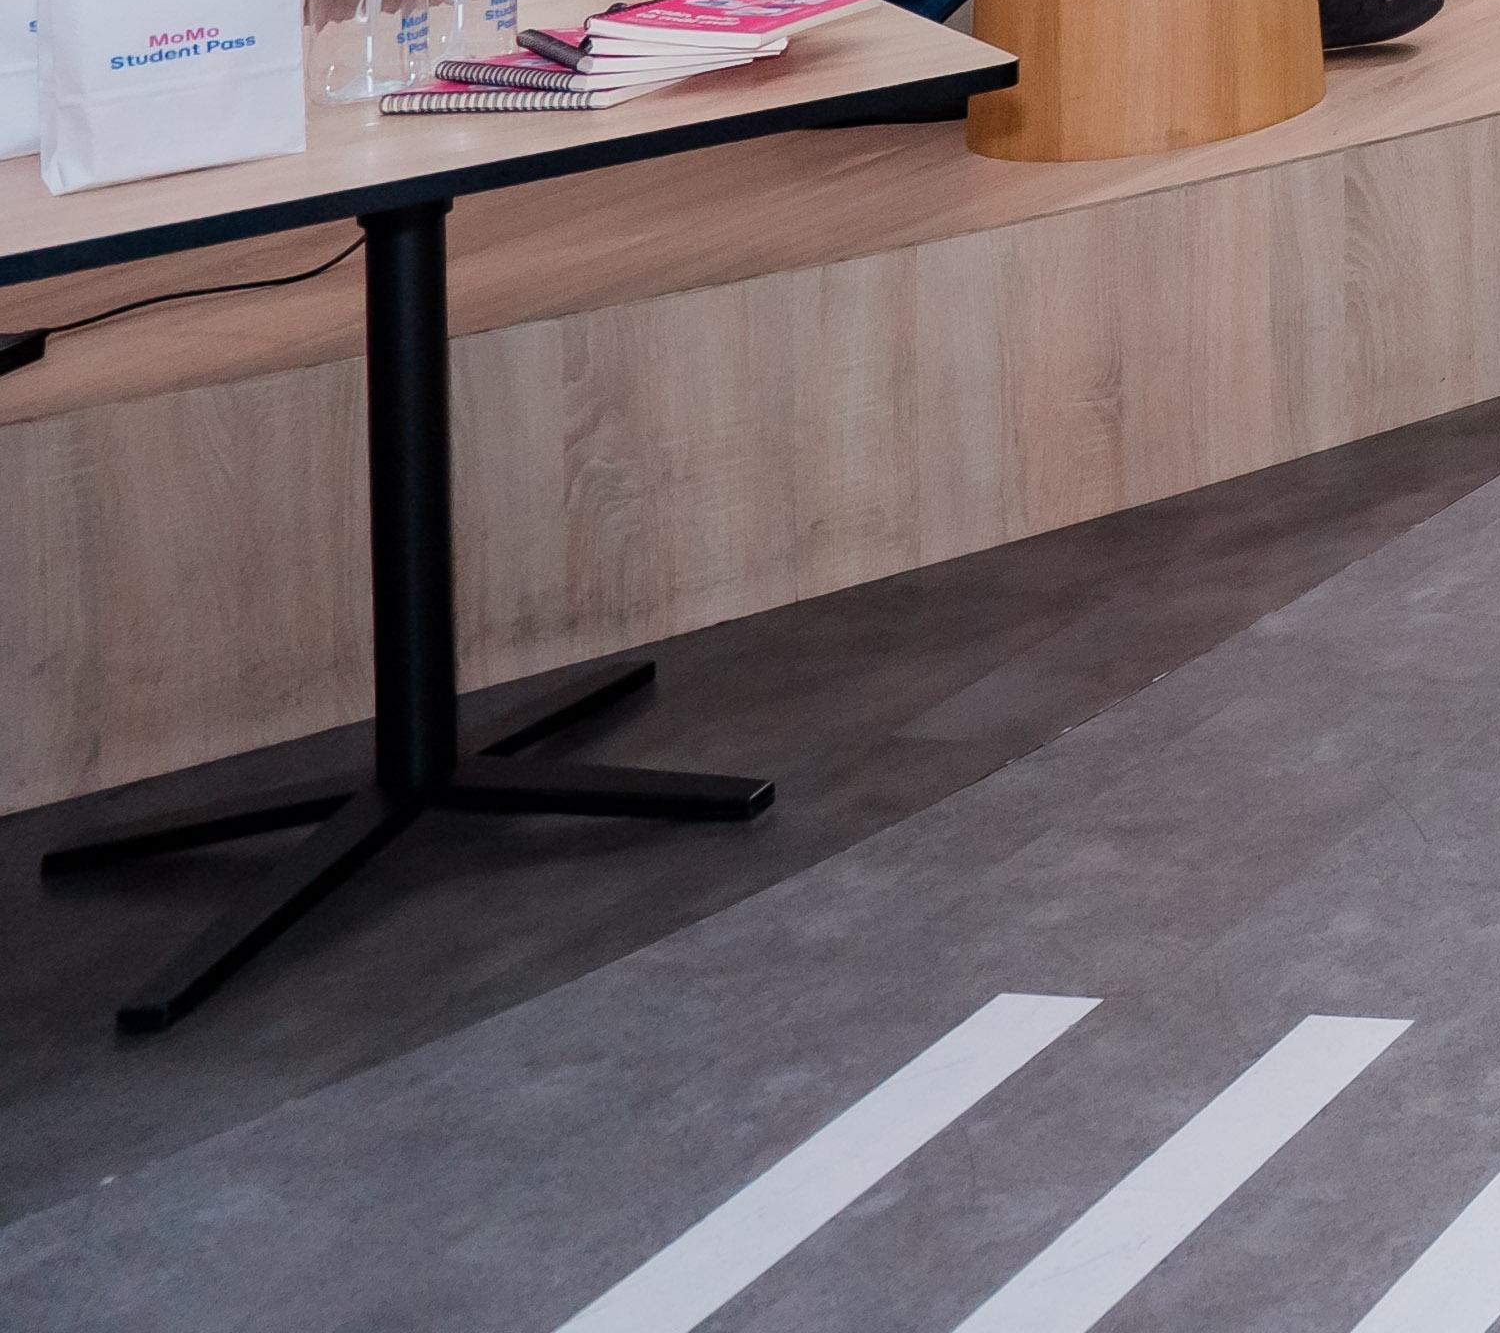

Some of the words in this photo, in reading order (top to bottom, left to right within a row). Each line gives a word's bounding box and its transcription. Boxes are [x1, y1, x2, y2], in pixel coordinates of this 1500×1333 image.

[149, 26, 220, 48] MoMo
[110, 43, 201, 71] Student
[206, 35, 257, 54] Pass
